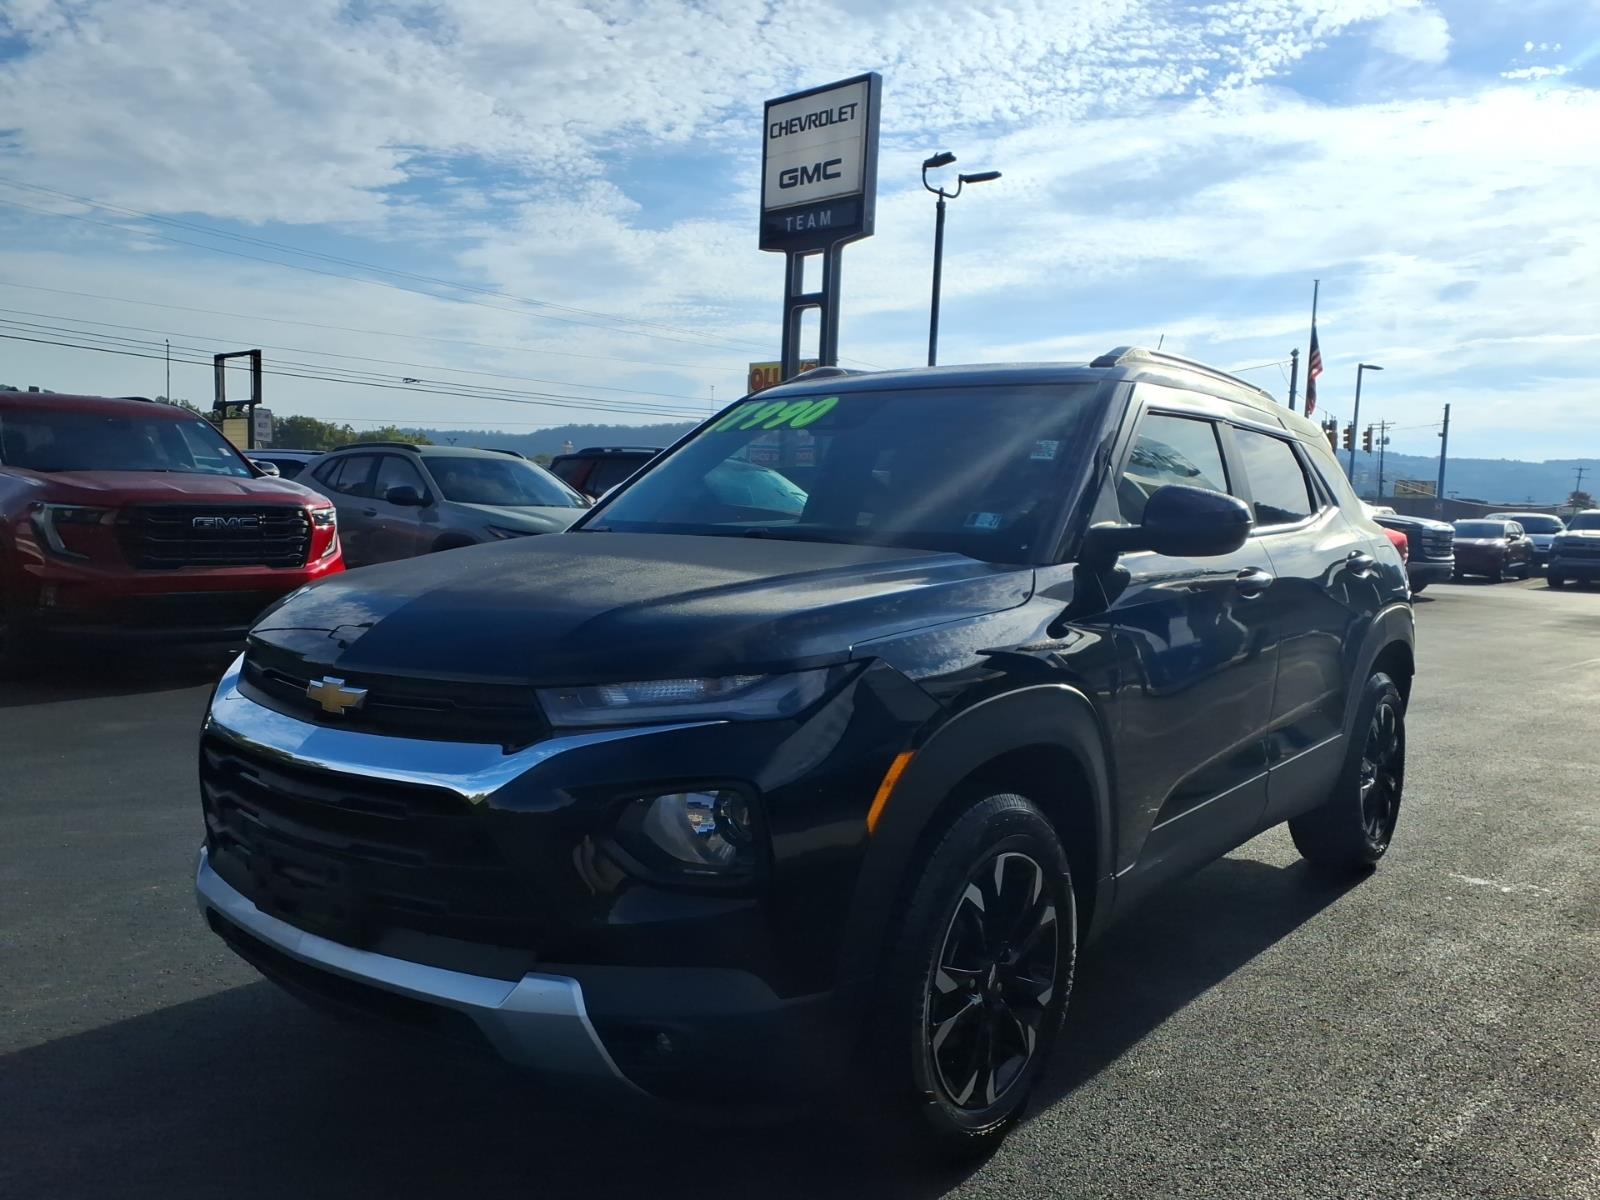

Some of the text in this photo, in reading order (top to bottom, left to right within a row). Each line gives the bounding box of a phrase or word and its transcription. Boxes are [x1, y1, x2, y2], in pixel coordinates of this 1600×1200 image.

[769, 102, 858, 139] CHEVROLET
[779, 158, 842, 189] GMC
[785, 210, 831, 232] TEAM
[192, 516, 258, 529] GMC
